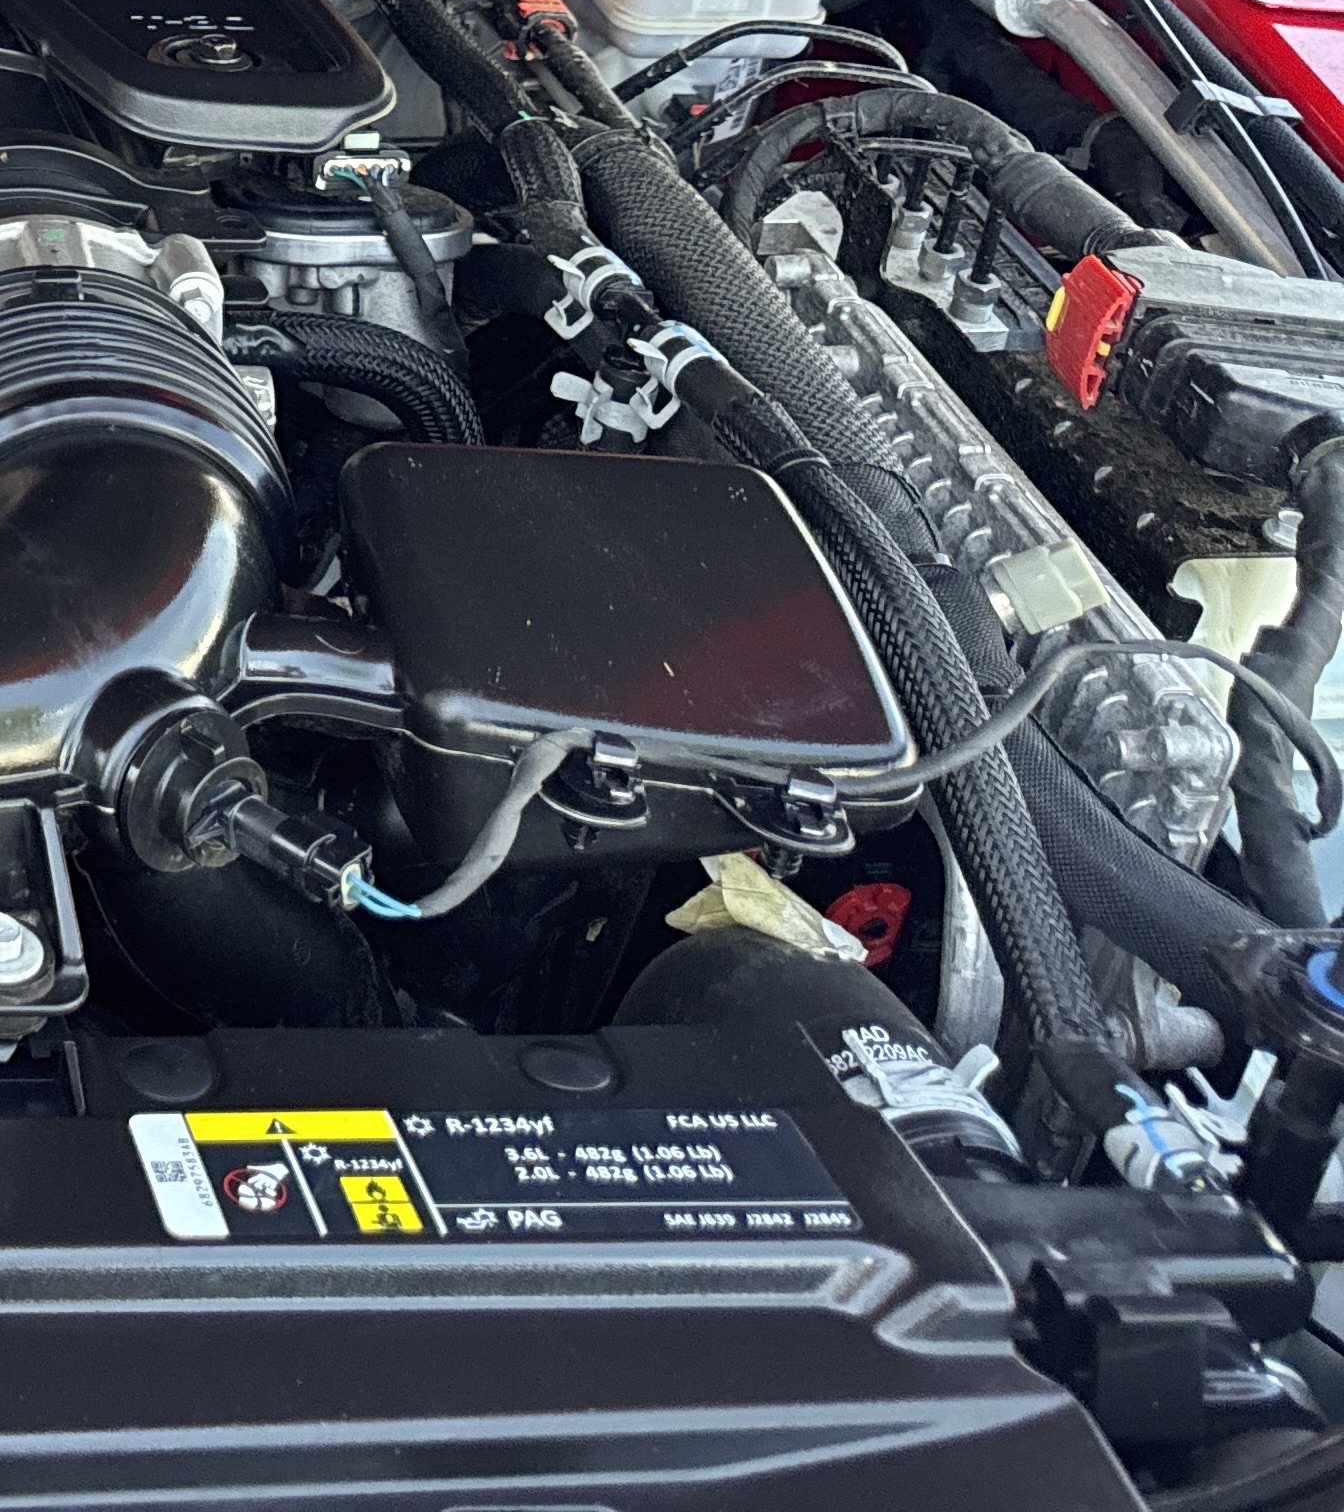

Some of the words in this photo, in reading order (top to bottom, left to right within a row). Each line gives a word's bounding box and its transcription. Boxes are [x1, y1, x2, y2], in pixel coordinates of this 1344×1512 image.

[444, 1115, 555, 1138] R-1234yf
[666, 1114, 708, 1129] FCA
[708, 1114, 740, 1129] US
[740, 1114, 778, 1129] LLC
[504, 1146, 550, 1162] 3.6L
[574, 1145, 627, 1164] 482g
[632, 1144, 685, 1163] (1.06
[686, 1144, 722, 1163] Lb)
[333, 1157, 404, 1173] R-1234yf
[514, 1166, 560, 1182] 2.0L
[585, 1165, 639, 1183] 482g
[642, 1164, 697, 1182] (1.06
[698, 1163, 734, 1184] Lb)
[507, 1209, 563, 1230] PAG
[664, 1213, 696, 1227] SAE
